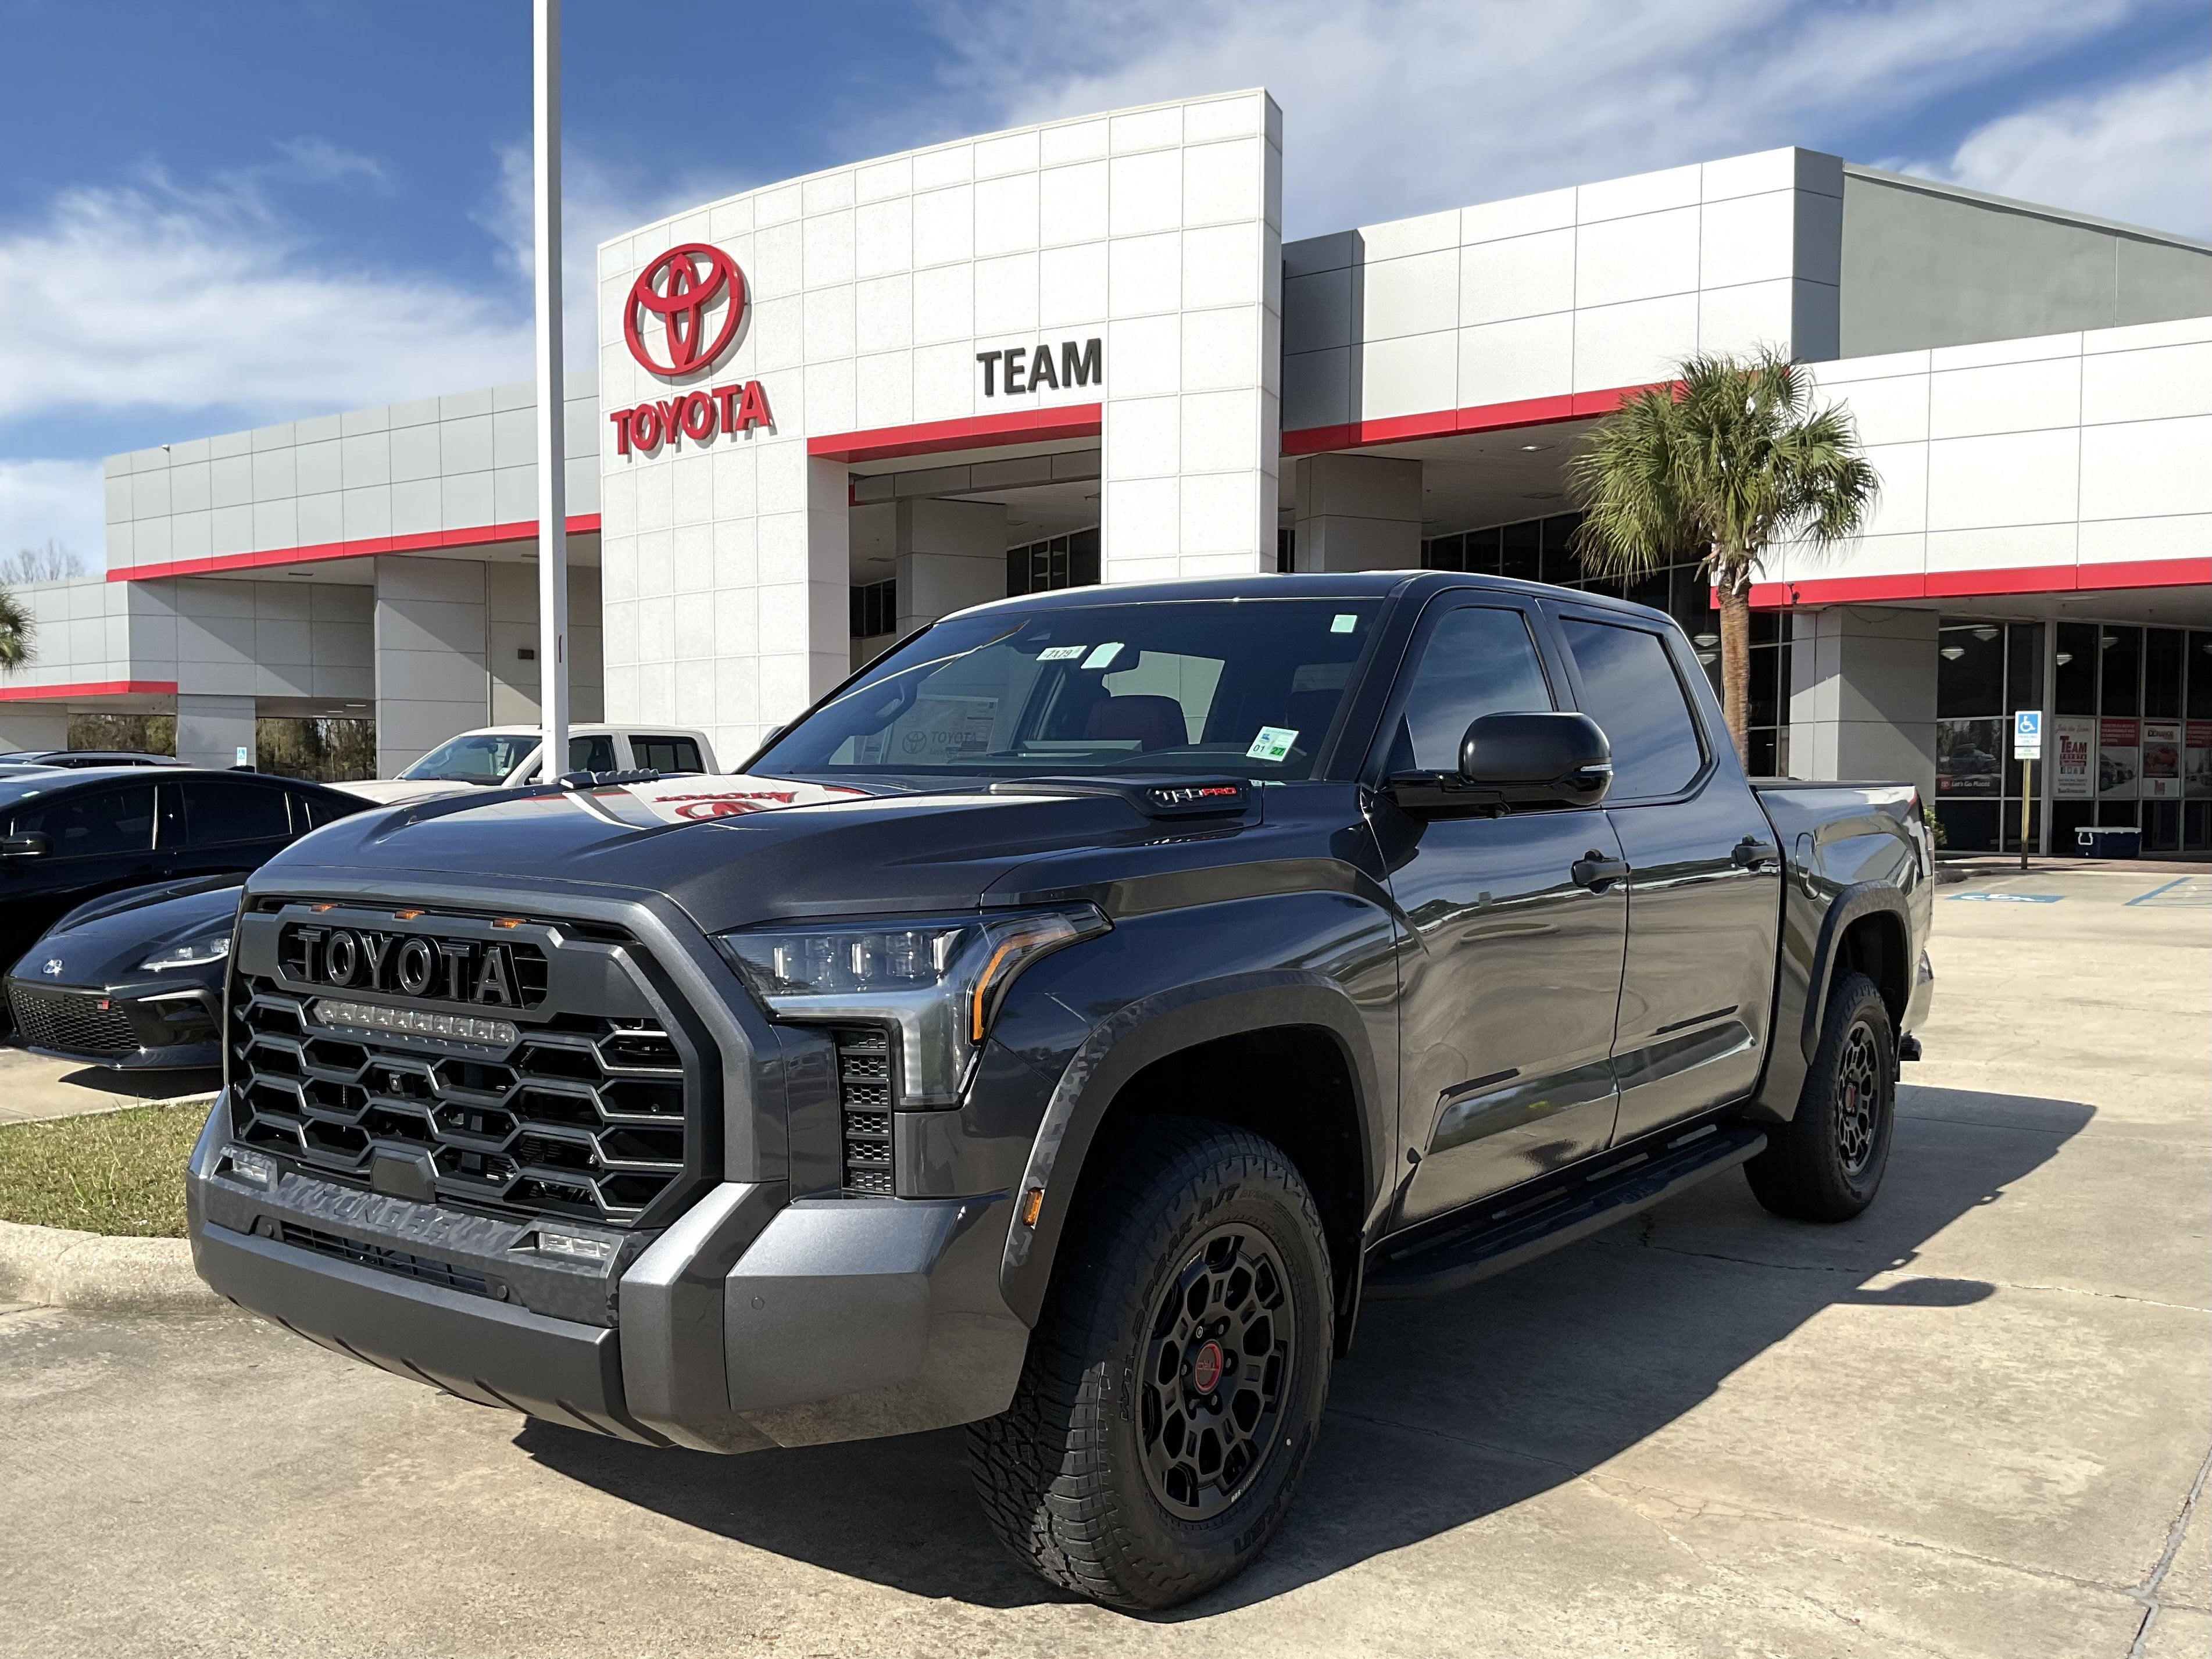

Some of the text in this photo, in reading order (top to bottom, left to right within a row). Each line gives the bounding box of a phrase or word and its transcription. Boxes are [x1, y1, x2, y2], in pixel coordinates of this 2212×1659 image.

[975, 337, 1102, 396] TEAM
[610, 380, 772, 455] TOYOTA
[1253, 744, 1265, 752] 01
[1270, 747, 1285, 756] 27
[1154, 786, 1237, 803] TRD PRO
[297, 928, 524, 1009] TOYOTA
